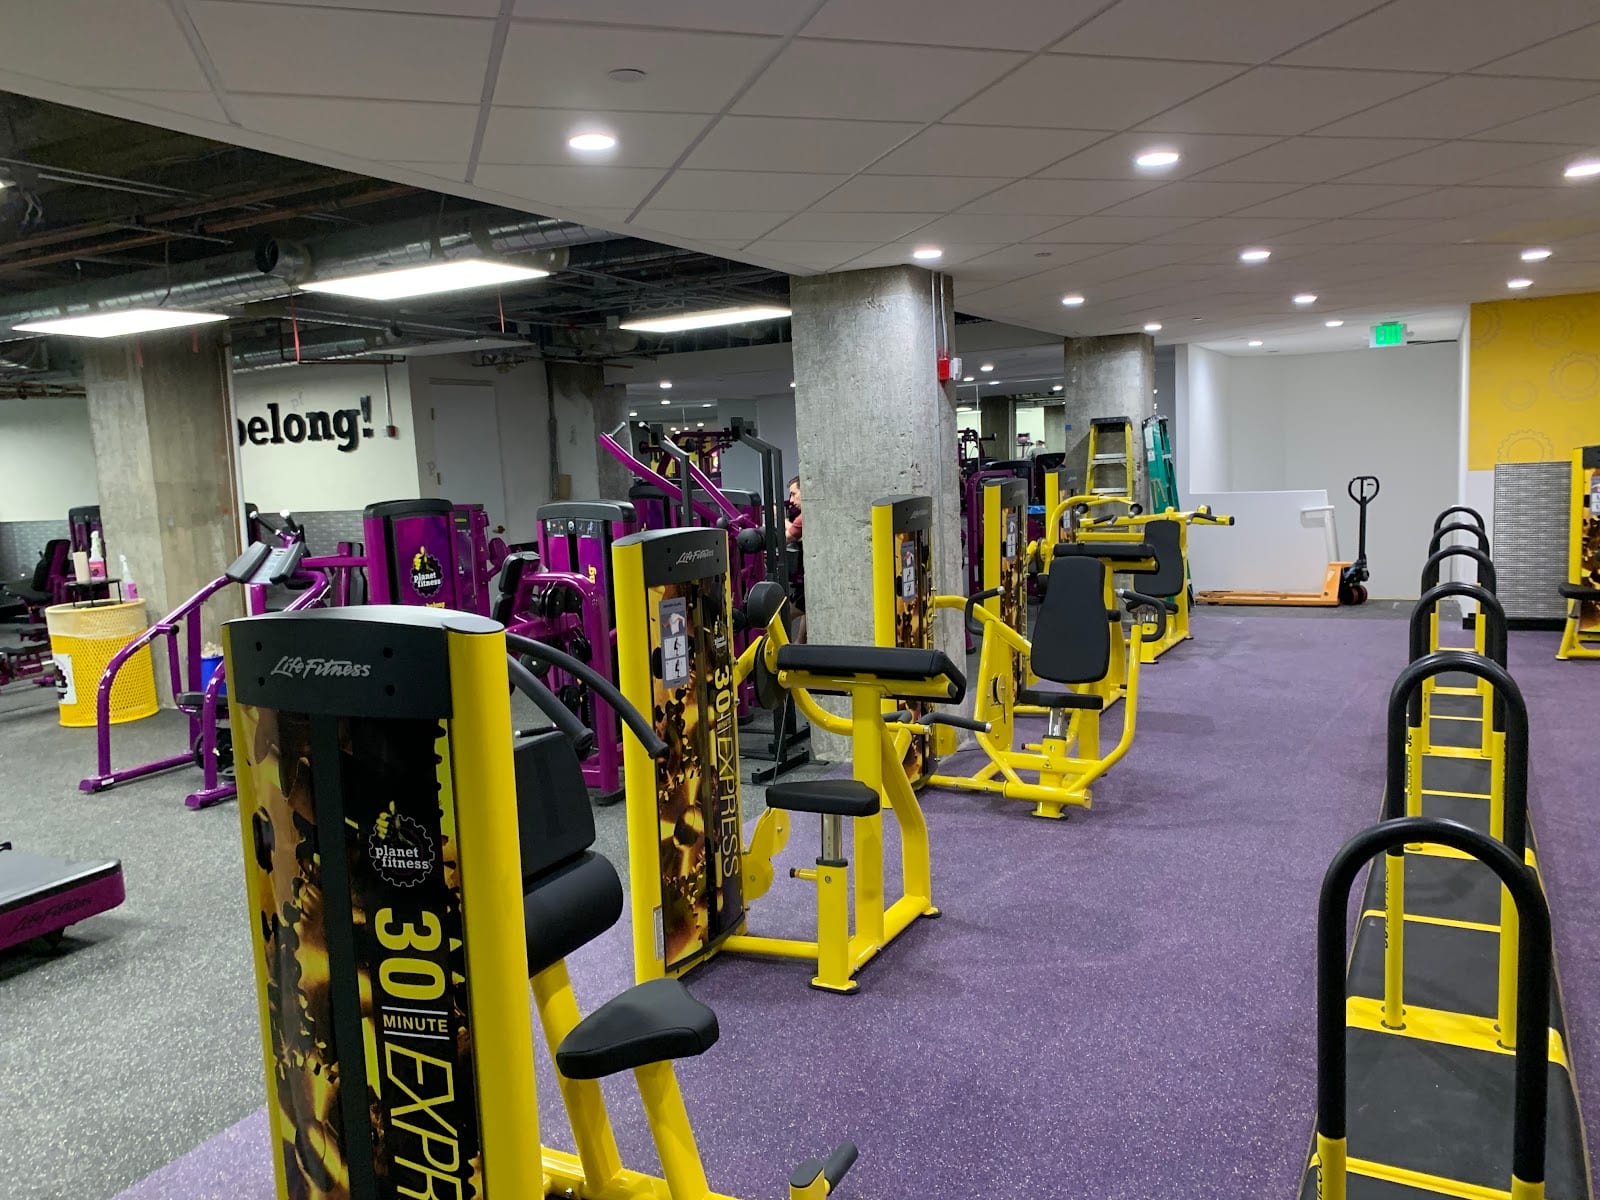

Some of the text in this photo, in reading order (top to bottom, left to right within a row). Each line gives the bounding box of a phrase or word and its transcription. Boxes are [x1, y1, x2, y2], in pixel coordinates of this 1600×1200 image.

[714, 665, 731, 713] 30
[717, 736, 739, 878] EXPRESS
[375, 845, 419, 859] planet
[381, 855, 430, 870] fitness
[374, 907, 446, 1001] 30
[382, 1014, 449, 1034] MINUTE
[384, 1041, 463, 1200] EXPR
